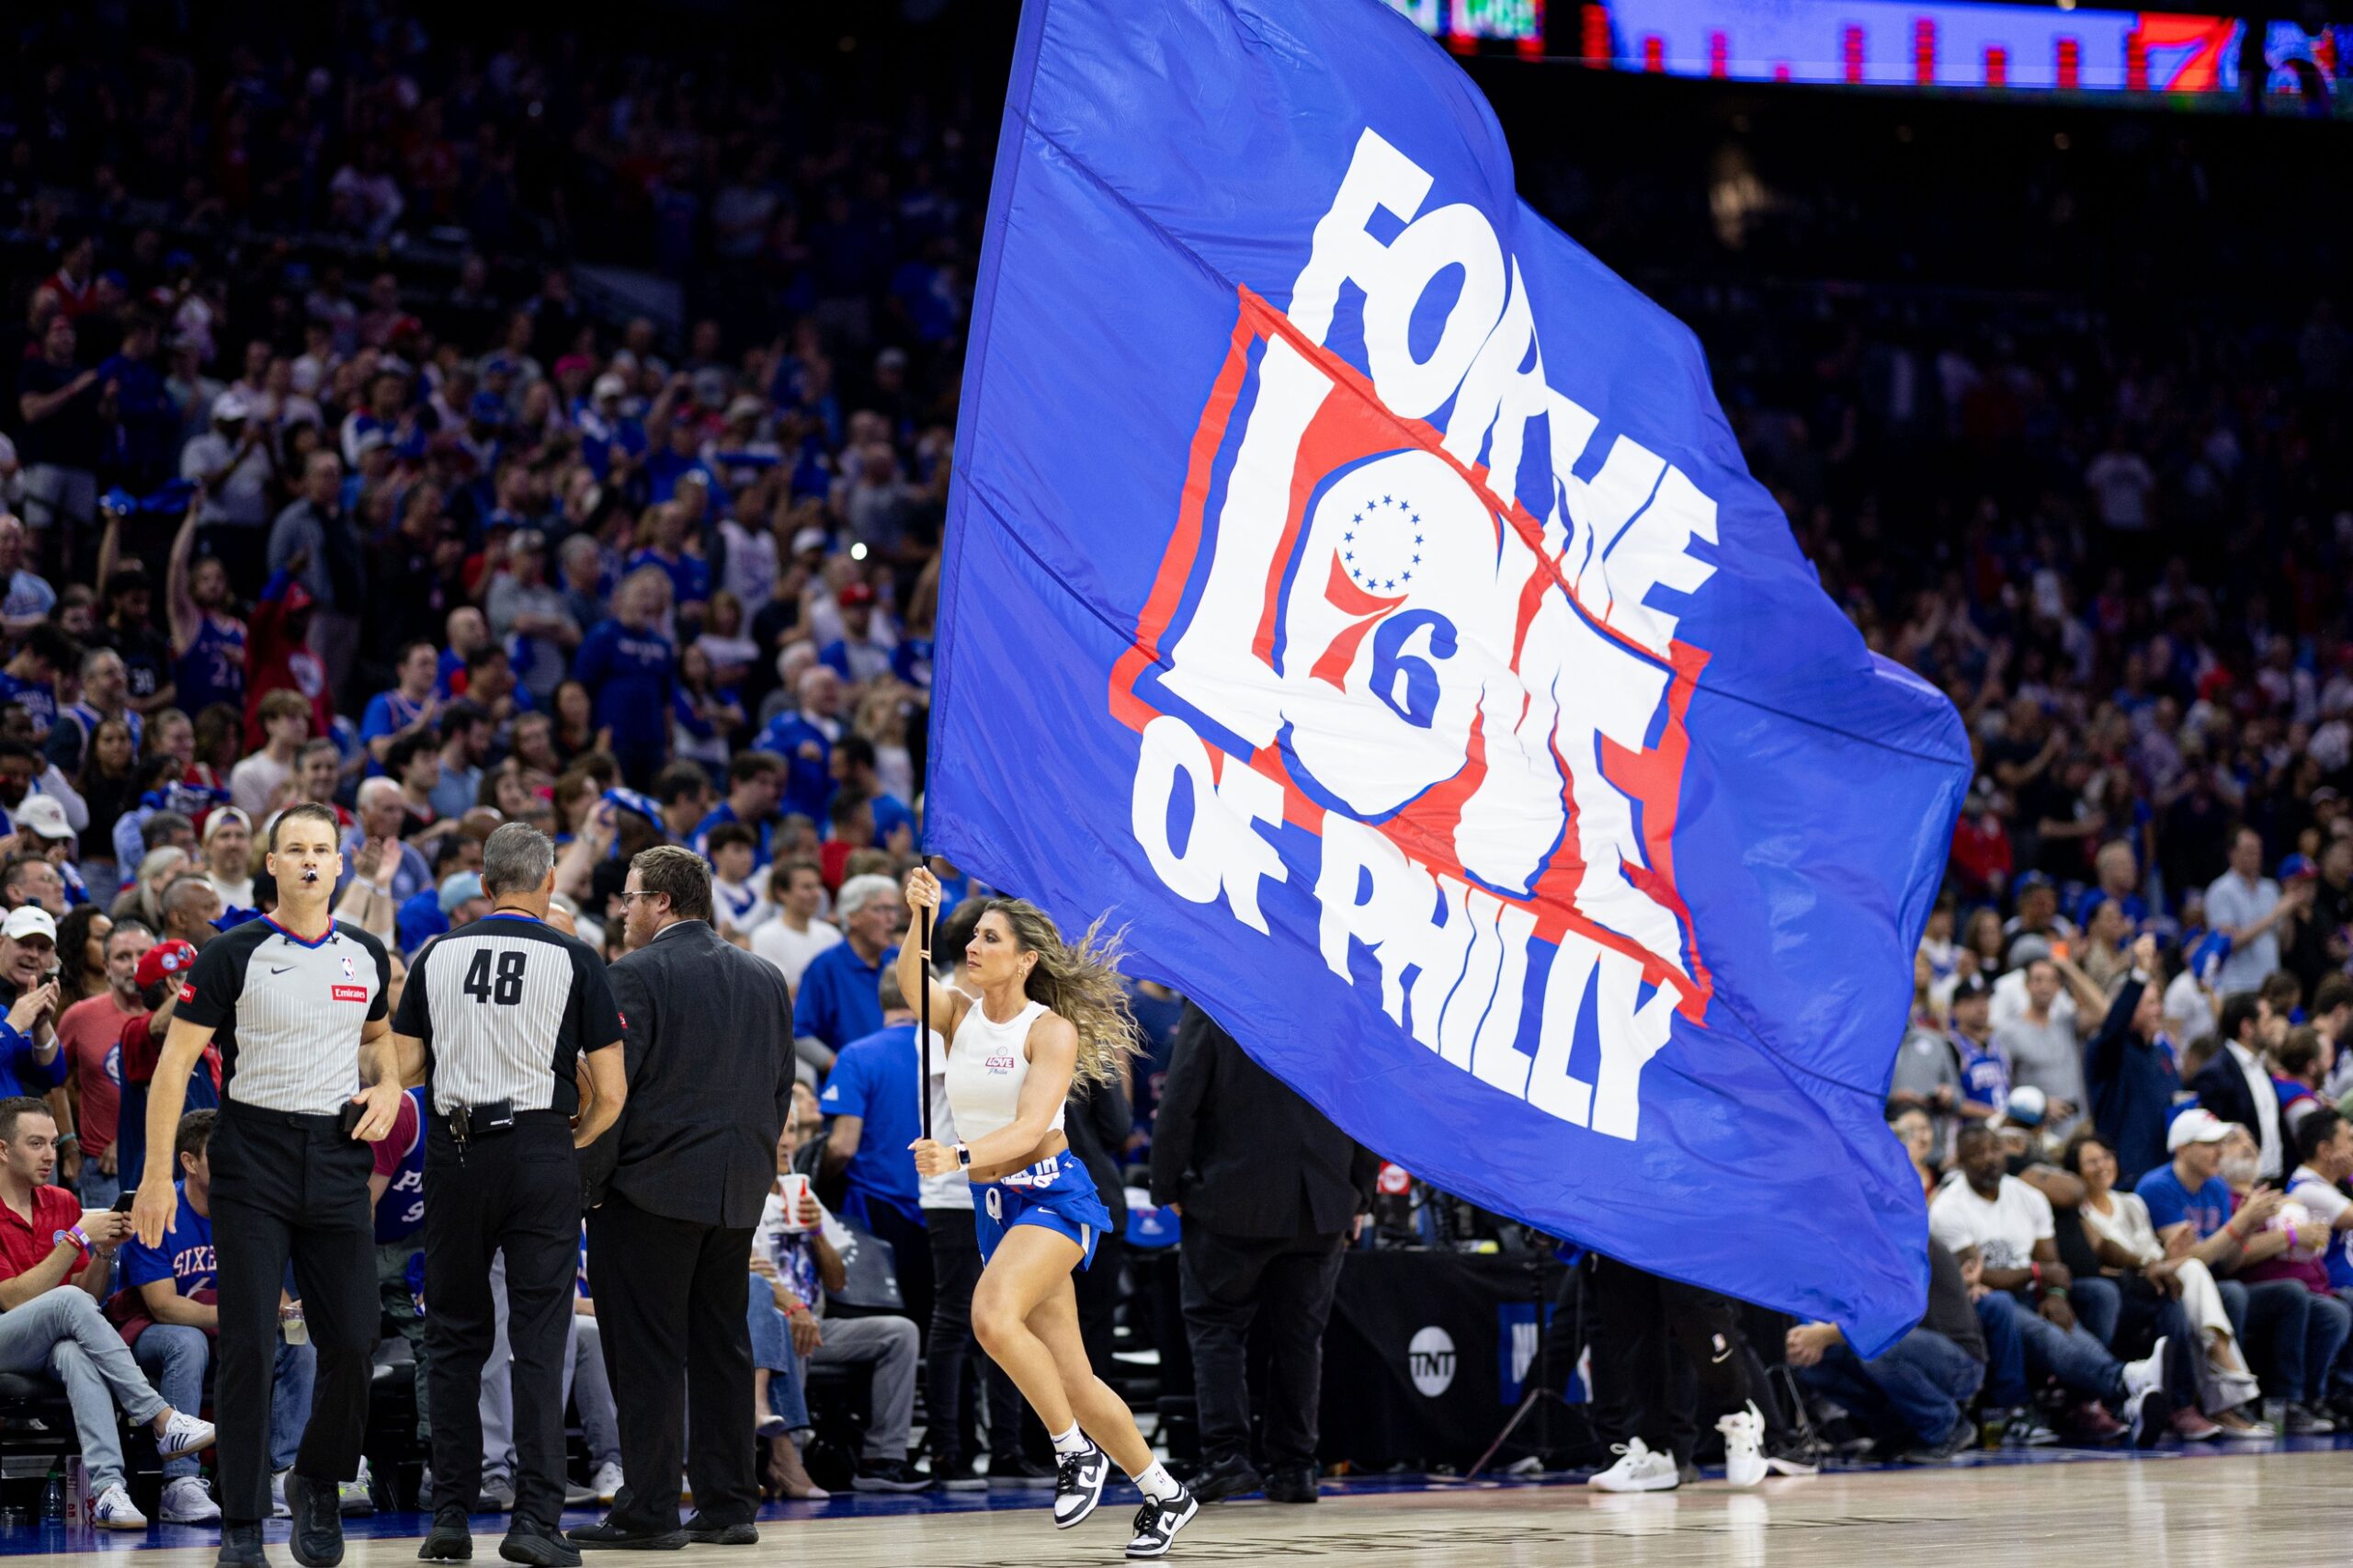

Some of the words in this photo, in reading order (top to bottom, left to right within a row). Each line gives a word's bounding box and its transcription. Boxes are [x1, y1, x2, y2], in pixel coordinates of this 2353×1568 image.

[1287, 126, 1553, 512] FOR
[1131, 714, 1289, 937] OF
[1313, 809, 1684, 1141] PHILLY
[335, 988, 366, 999] Emirates
[463, 949, 527, 1006] 48
[985, 1057, 1014, 1068] LOVE
[1408, 1352, 1456, 1378] TNT
